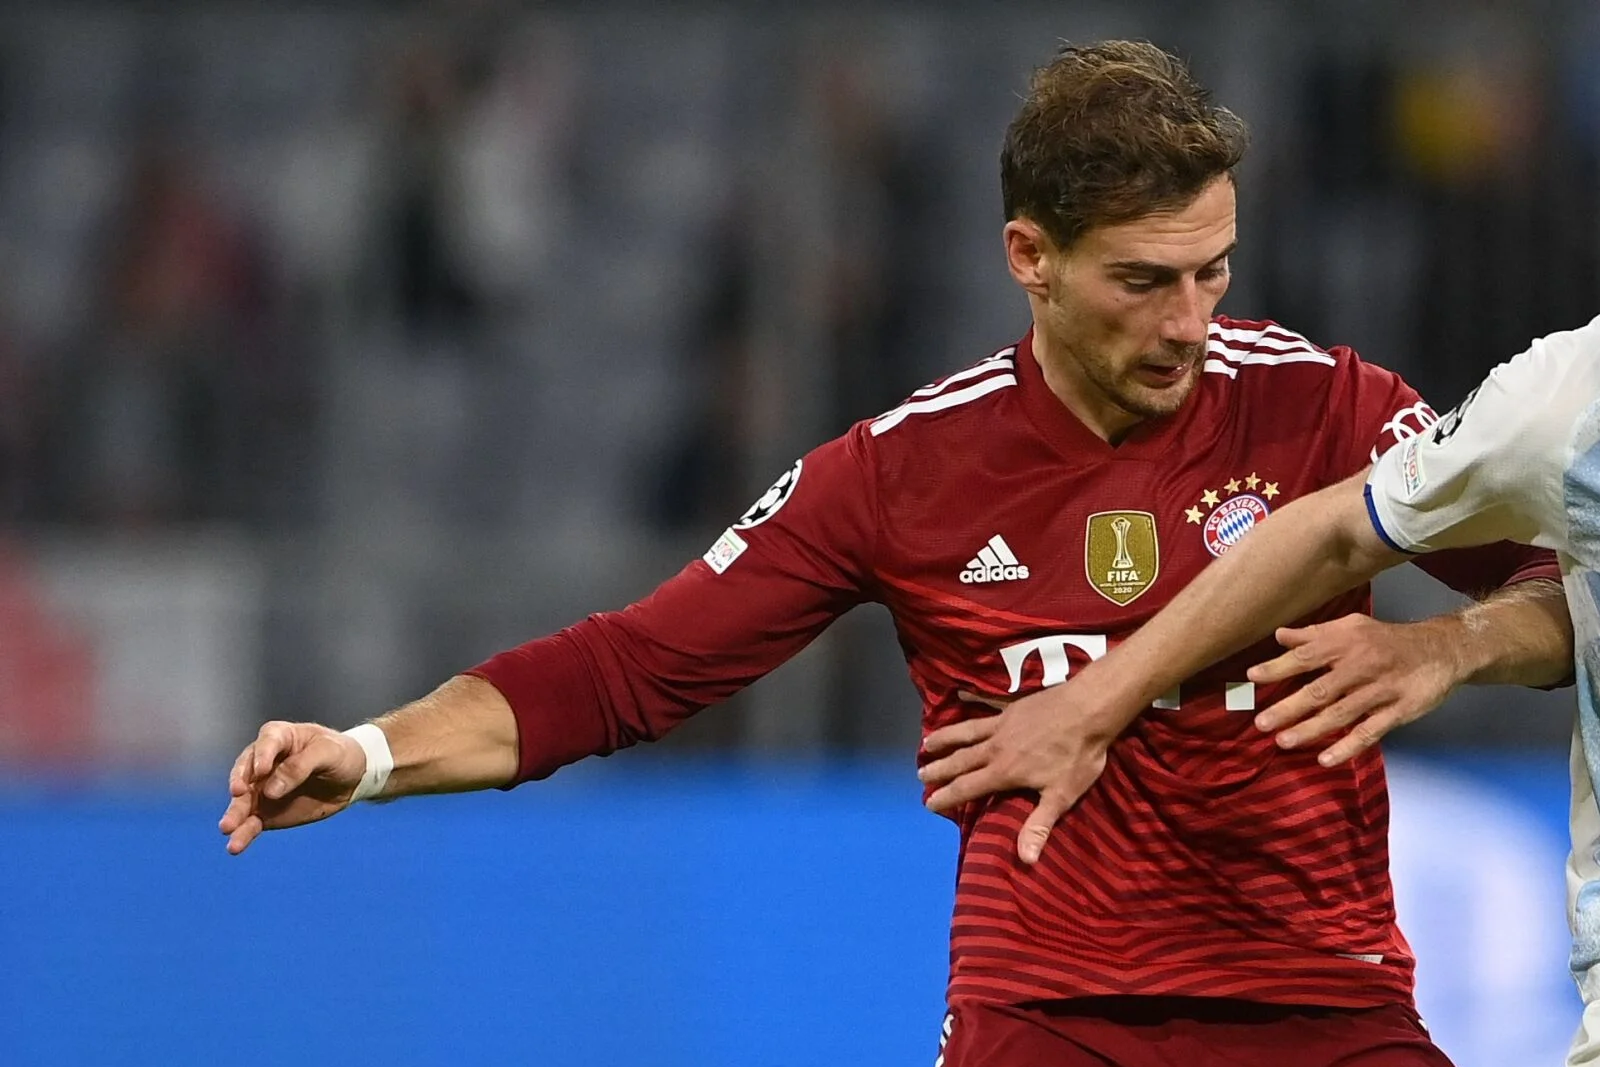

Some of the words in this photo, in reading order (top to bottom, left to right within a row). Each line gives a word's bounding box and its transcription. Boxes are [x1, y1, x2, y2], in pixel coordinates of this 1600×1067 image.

[1207, 514, 1221, 532] FC
[1220, 499, 1263, 517] BAYERN
[959, 565, 1029, 583] adidas
[1107, 570, 1139, 582] FIFA
[1112, 586, 1133, 594] 2020
